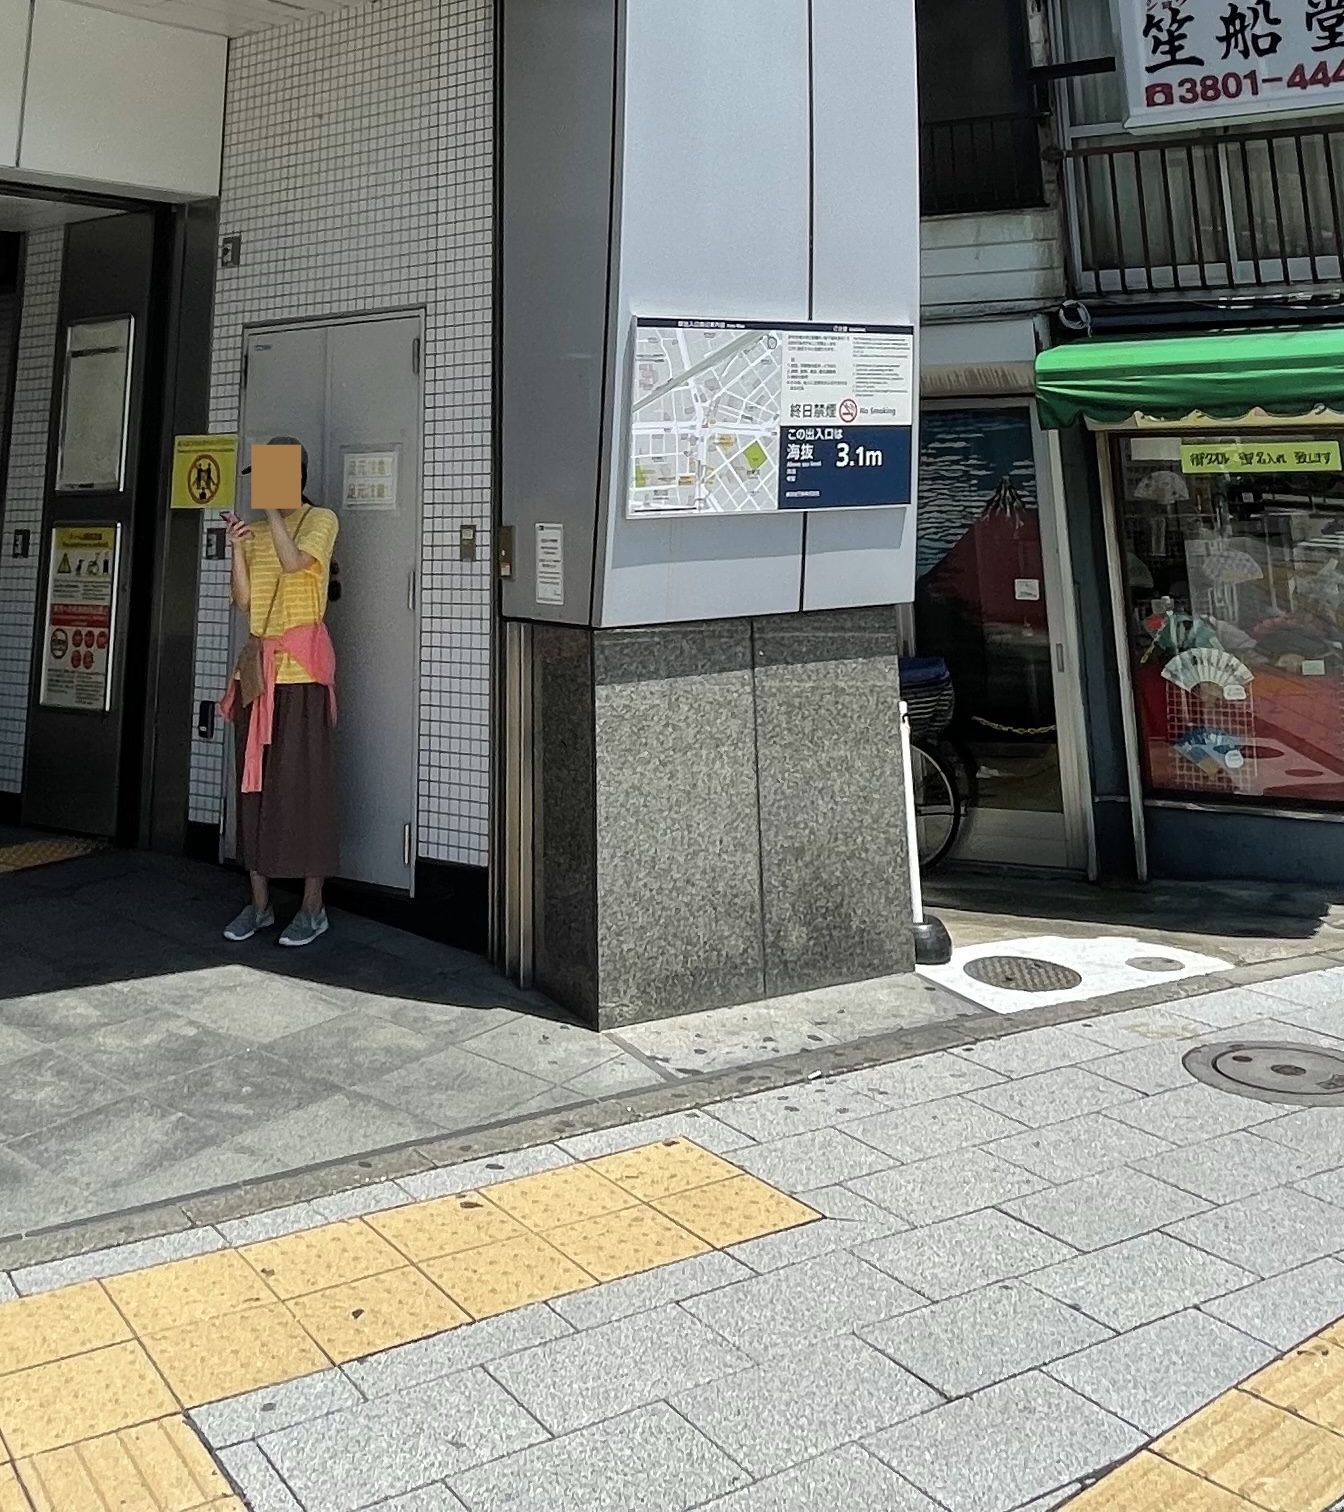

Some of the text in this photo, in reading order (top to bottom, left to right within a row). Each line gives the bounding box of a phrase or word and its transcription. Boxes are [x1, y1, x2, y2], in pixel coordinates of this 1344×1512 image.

[789, 403, 837, 419] 終日禁煙
[870, 407, 896, 416] Smoking
[787, 428, 844, 441] この出入口は
[786, 442, 883, 467] 海抜 3.1m
